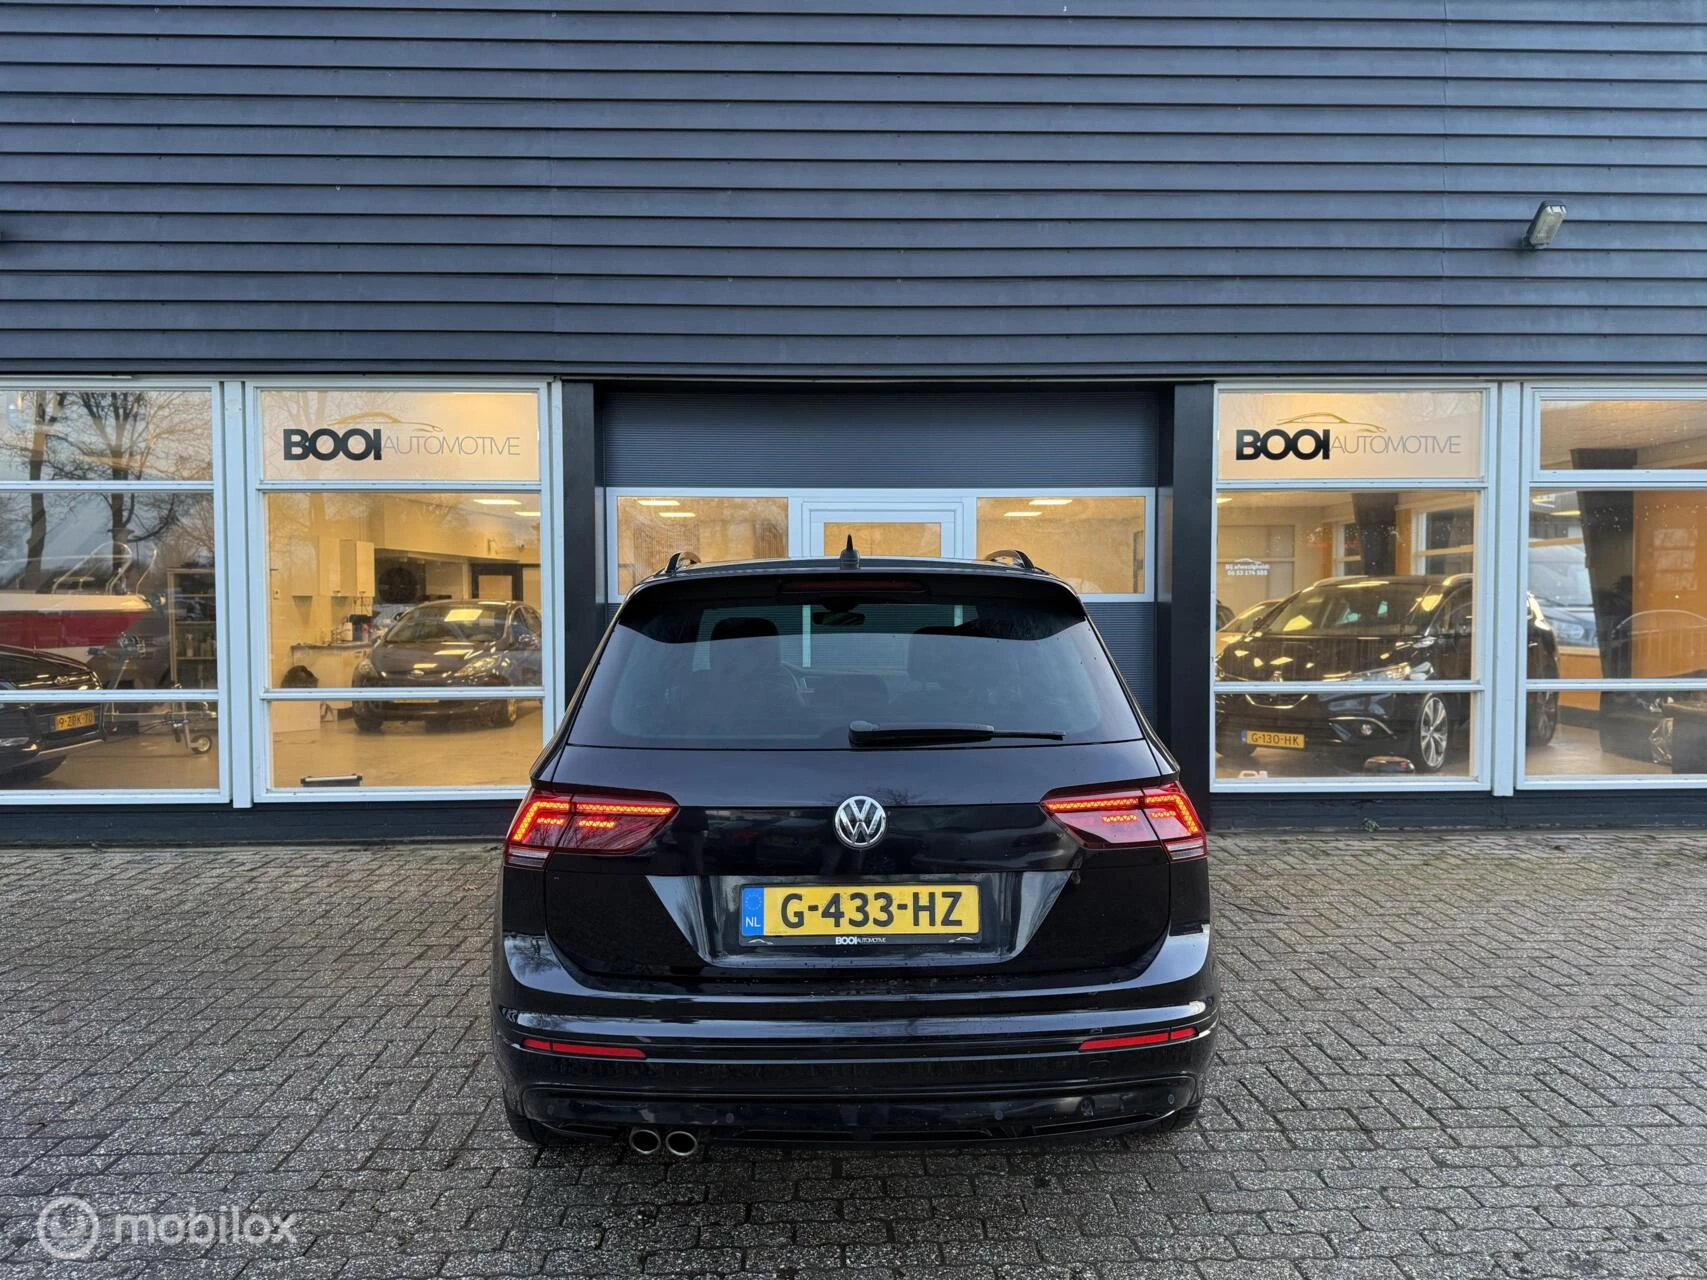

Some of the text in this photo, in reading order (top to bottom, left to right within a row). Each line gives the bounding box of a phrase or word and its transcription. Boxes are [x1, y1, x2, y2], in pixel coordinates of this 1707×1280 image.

[283, 428, 521, 461] BOOI AUTOMOTIVE
[1236, 429, 1461, 461] BOOI AUTOMOTIVE
[1251, 732, 1300, 746] G-130-HK
[780, 891, 963, 928] G-433-HZ
[745, 917, 761, 928] NL
[835, 936, 858, 945] BOOI
